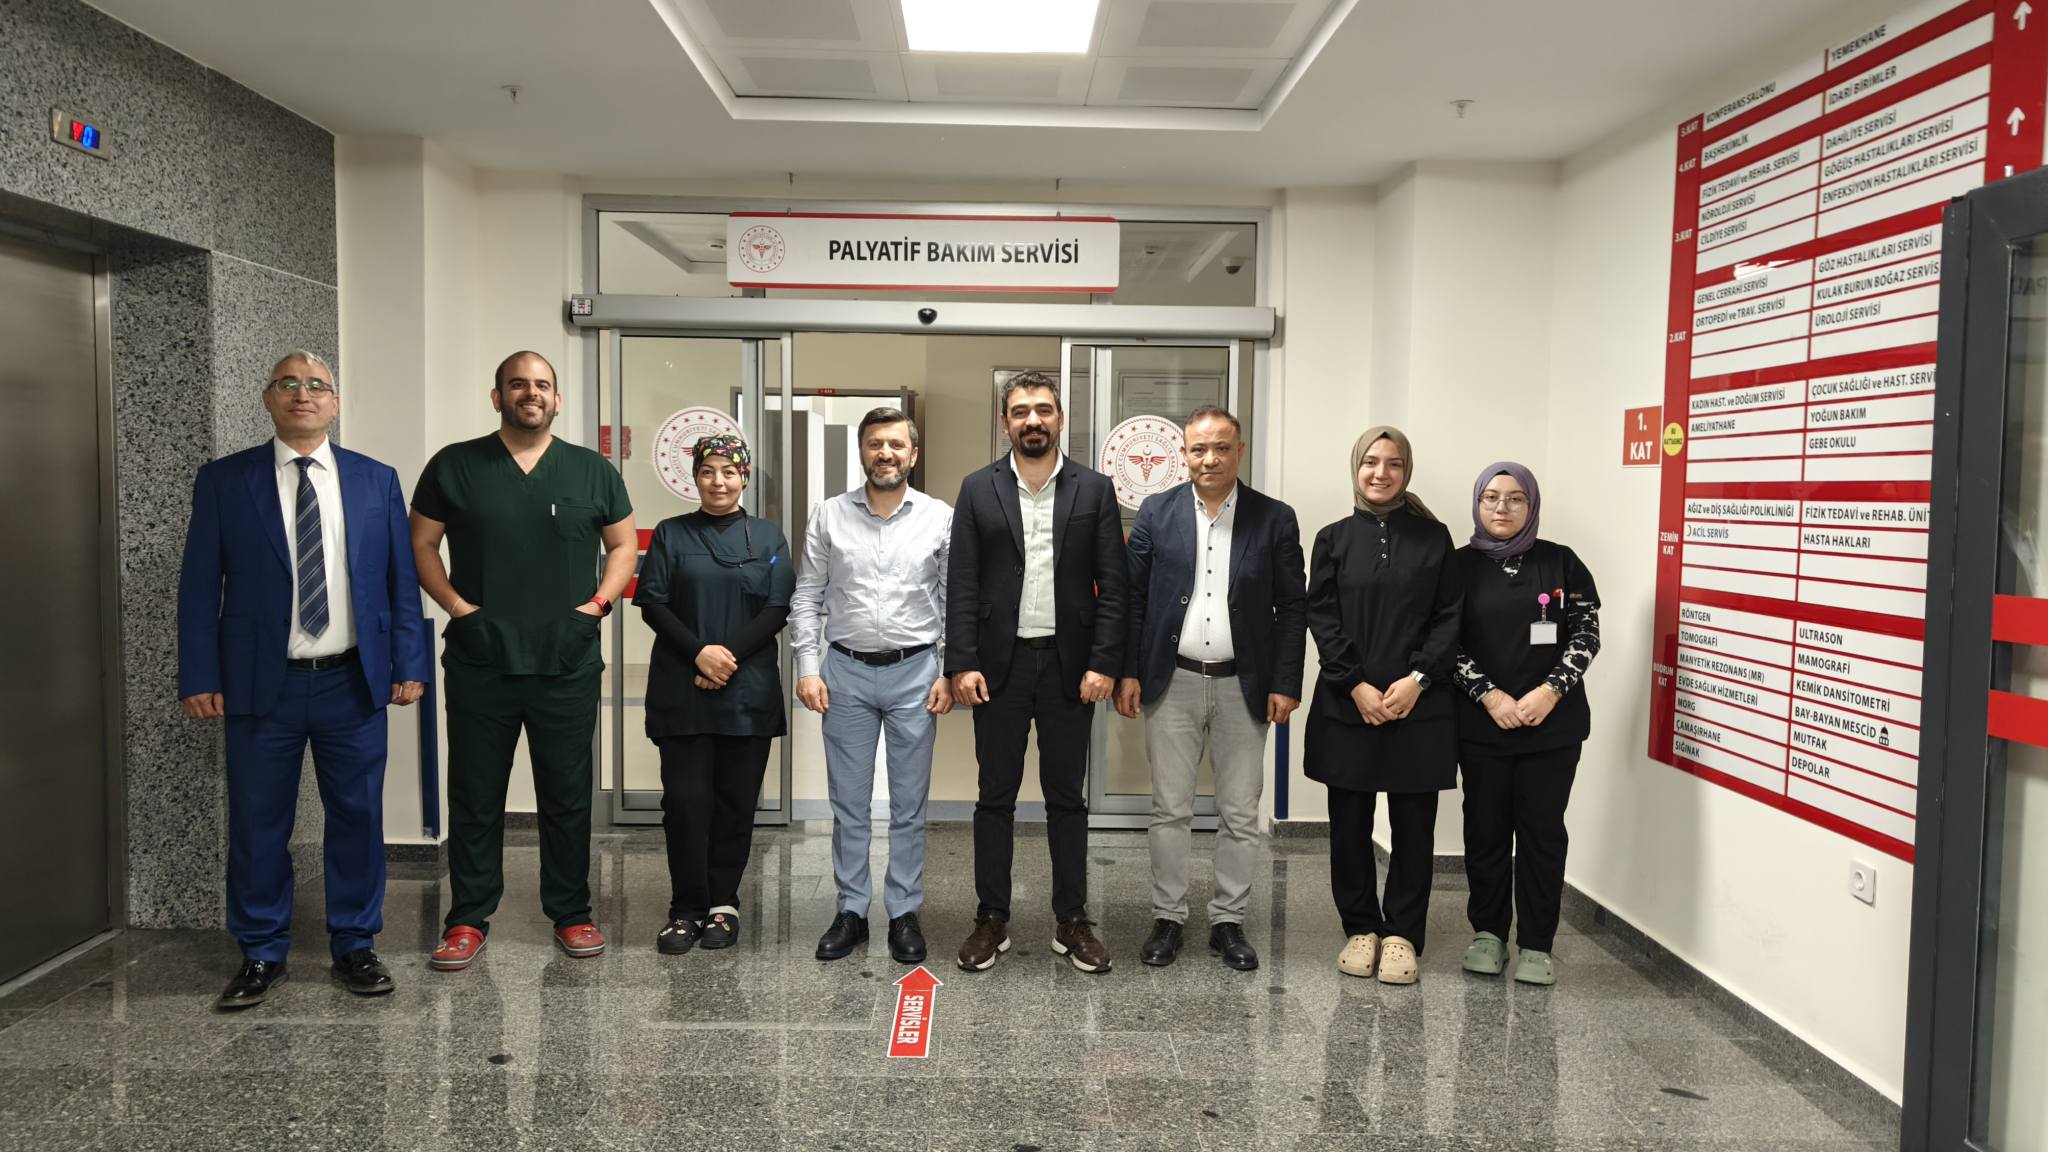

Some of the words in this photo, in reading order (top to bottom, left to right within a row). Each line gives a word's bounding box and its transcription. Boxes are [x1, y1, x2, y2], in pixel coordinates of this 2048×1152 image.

[1831, 24, 1886, 61] YEMEKHANE
[1829, 84, 1852, 105] İDARİ
[1854, 66, 1897, 95] BİRİMLER
[1706, 95, 1746, 123] KONFERANS
[1746, 82, 1776, 106] SALONU
[1826, 126, 1862, 149] DAHİLİYE
[1864, 109, 1896, 135] SERVİSİ
[1704, 134, 1749, 162] BAŞHEKİMLİK
[1825, 155, 1853, 177] GÖĞÜS
[1854, 134, 1915, 165] HASTALIKLARI
[1917, 116, 1953, 143] SERVİSİ
[1773, 150, 1800, 171] SERVİSİ
[1823, 177, 1872, 204] ENFEKSİYON
[1873, 155, 1938, 188] HASTALIKLARI
[1940, 137, 1978, 164] SERVİSİ
[1732, 191, 1755, 210] SERVİSİ
[1724, 219, 1747, 237] SERVİSİ
[829, 236, 921, 262] PALYATİF
[927, 240, 995, 263] BAKIM
[1001, 238, 1079, 264] SERVİSİ
[1819, 256, 1836, 273] GÖZ
[1837, 242, 1896, 268] HASTALIKLARI
[1898, 230, 1932, 253] SERVİSİ
[1697, 292, 1715, 304] GENEL
[1716, 283, 1743, 299] CERRAHİ
[1744, 276, 1768, 293] SERVİSİ
[1817, 284, 1843, 301] KULAK
[1844, 278, 1872, 295] BURUN
[1874, 270, 1905, 288] BOĞAZ
[1696, 310, 1728, 327] ORTOPEDİ
[1729, 312, 1736, 320] ve
[1737, 306, 1756, 319] TRAV.
[1757, 296, 1785, 315] SERVİSİ
[1815, 307, 1848, 327] ÜROLOJİ
[1849, 302, 1881, 321] SERVİSİ
[1812, 382, 1838, 398] ÇOCUK
[1839, 377, 1871, 393] SAĞLIĞI
[1872, 380, 1882, 389] ve
[1884, 374, 1908, 387] HAST.
[1692, 397, 1709, 410] KADIN
[1710, 396, 1726, 408] HAST.
[1727, 397, 1734, 405] ve
[1735, 393, 1760, 406] DOĞUM
[1761, 387, 1785, 402] SERVİSİ
[1637, 413, 1647, 431] 1.
[1691, 419, 1736, 433] AMELİYATHANE
[1811, 408, 1838, 423] YOĞUN
[1840, 407, 1867, 420] BAKIM
[1630, 441, 1653, 461] KAT
[1809, 437, 1828, 449] GEBE
[1829, 436, 1856, 448] OKULU
[1688, 503, 1702, 513] AĞIZ
[1702, 506, 1710, 514] ve
[1711, 503, 1722, 517] DİŞ
[1722, 503, 1749, 516] SAĞLIĞI
[1750, 503, 1794, 518] POLİKLİNİĞİ
[1805, 506, 1828, 519] FİZİK
[1828, 507, 1858, 520] TEDAVİ
[1860, 511, 1870, 520] ve
[1872, 509, 1906, 522] REHAB.
[1660, 530, 1679, 542] ZEMİN
[1692, 526, 1706, 537] ACİL
[1707, 526, 1729, 539] SERVİS
[1804, 533, 1830, 545] HASTA
[1832, 535, 1871, 548] HAKLARI
[1663, 546, 1674, 555] KAT
[1681, 607, 1711, 622] RÖNTGEN
[1681, 631, 1718, 647] TOMOGRAFİ
[1799, 627, 1843, 645] ULTRASON
[1680, 653, 1711, 669] MANYETİK
[1712, 661, 1747, 679] REZONANS
[1748, 668, 1764, 683] (MR)
[1798, 653, 1850, 675] MAMOGRAFİ
[1678, 676, 1694, 689] EVDE
[1695, 681, 1717, 695] SAĞLIK
[1718, 685, 1758, 706] HİZMETLERİ
[1796, 680, 1822, 695] KEMİK
[1823, 686, 1890, 712] DANSİTOMETRİ
[1677, 697, 1695, 711] MORG
[1676, 720, 1720, 743] ÇAMAŞIRHANE
[1795, 706, 1841, 728] BAY-BAYAN
[1842, 719, 1876, 738] MESCİD
[1675, 740, 1700, 758] SIĞINAK
[1793, 731, 1827, 751] MUTFAK
[1791, 756, 1830, 778] DEPOLAR
[897, 995, 927, 1044] SERVİSLER
